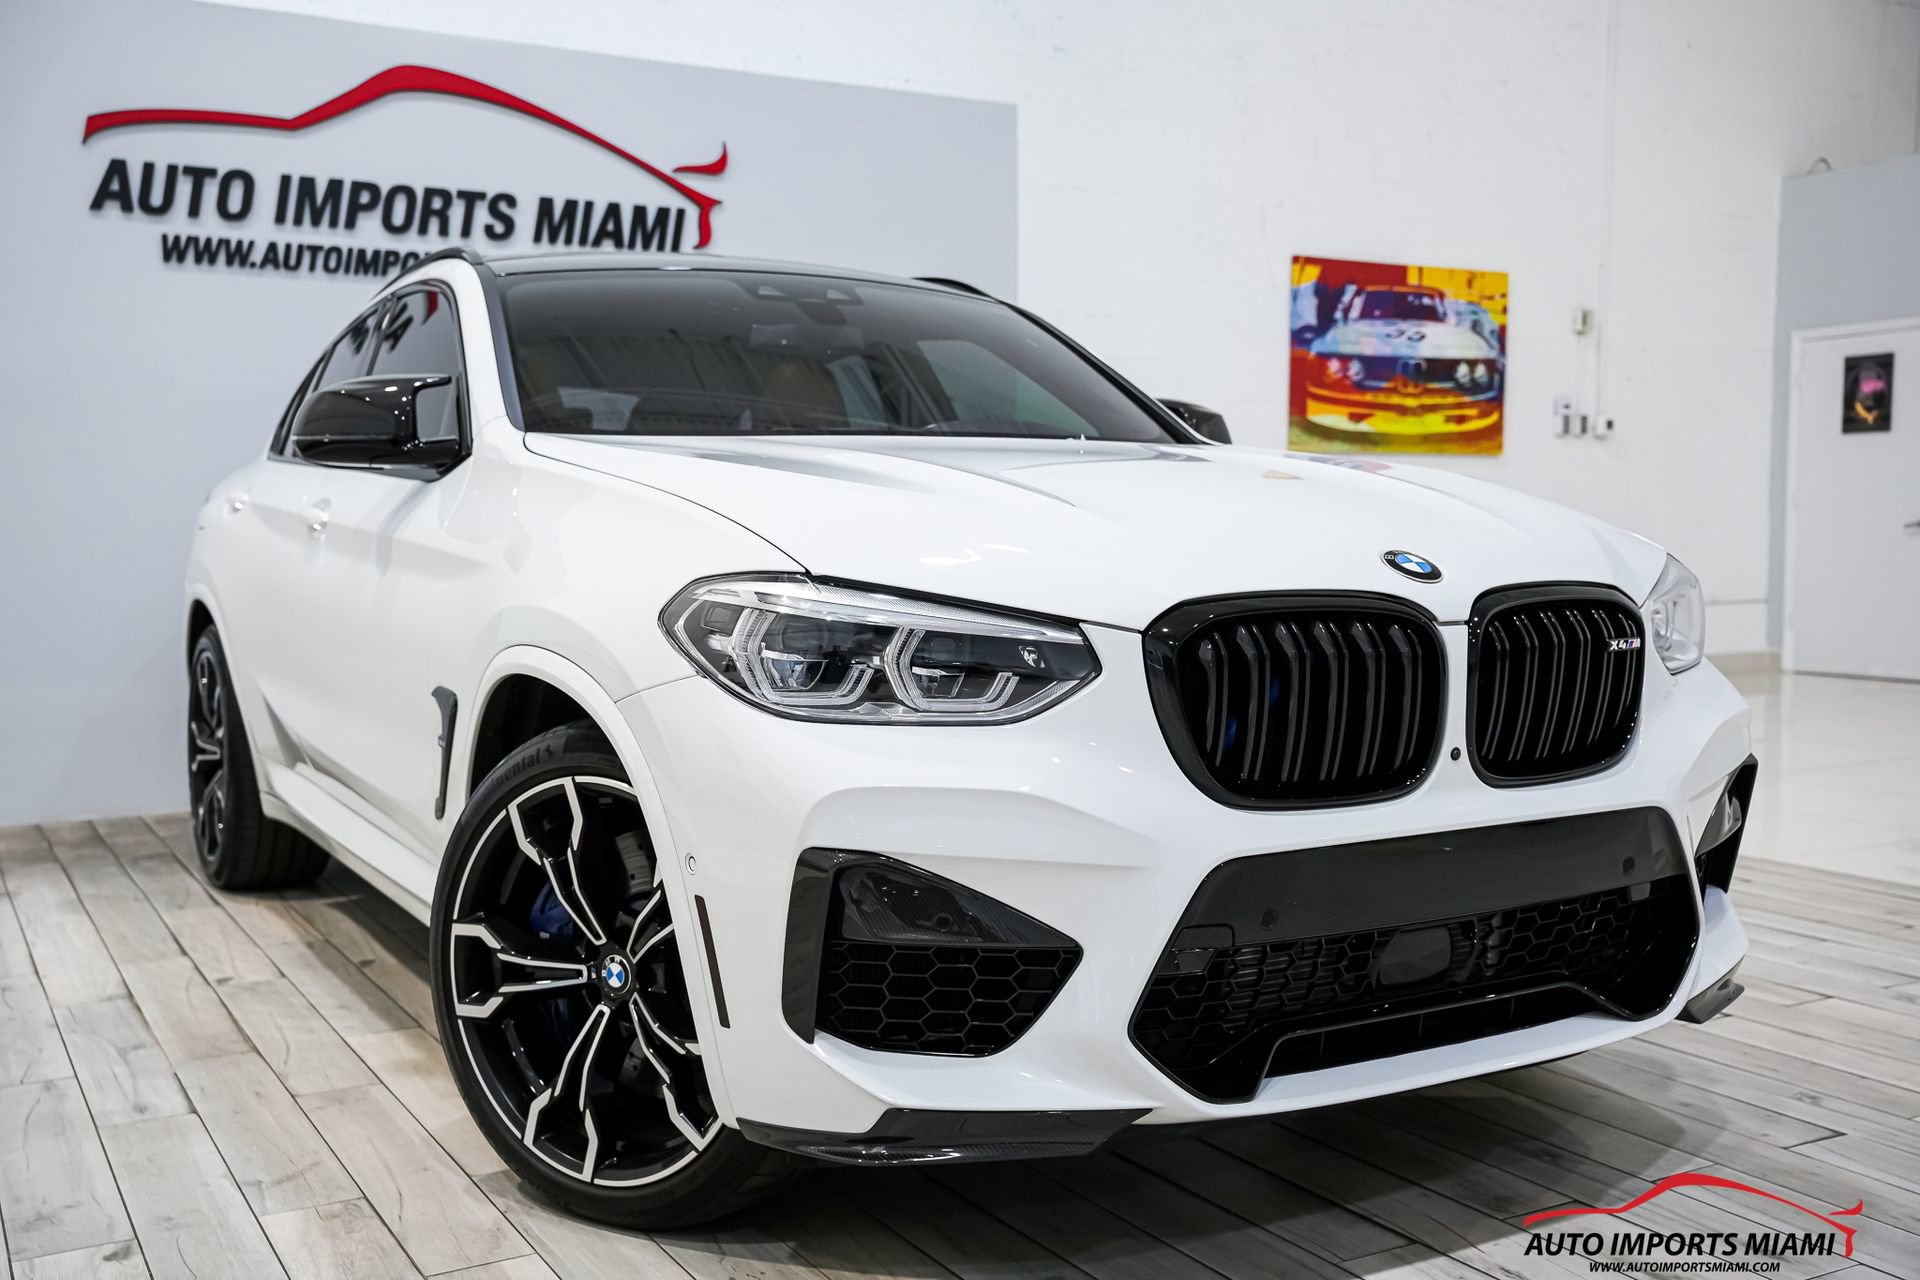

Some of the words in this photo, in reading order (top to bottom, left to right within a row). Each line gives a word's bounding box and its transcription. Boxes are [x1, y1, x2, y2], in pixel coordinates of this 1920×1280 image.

[89, 157, 256, 223] AUTO
[273, 173, 517, 243] IMPORTS
[532, 196, 687, 254] MIAMI
[160, 234, 432, 278] WWW.AUTOIMPO
